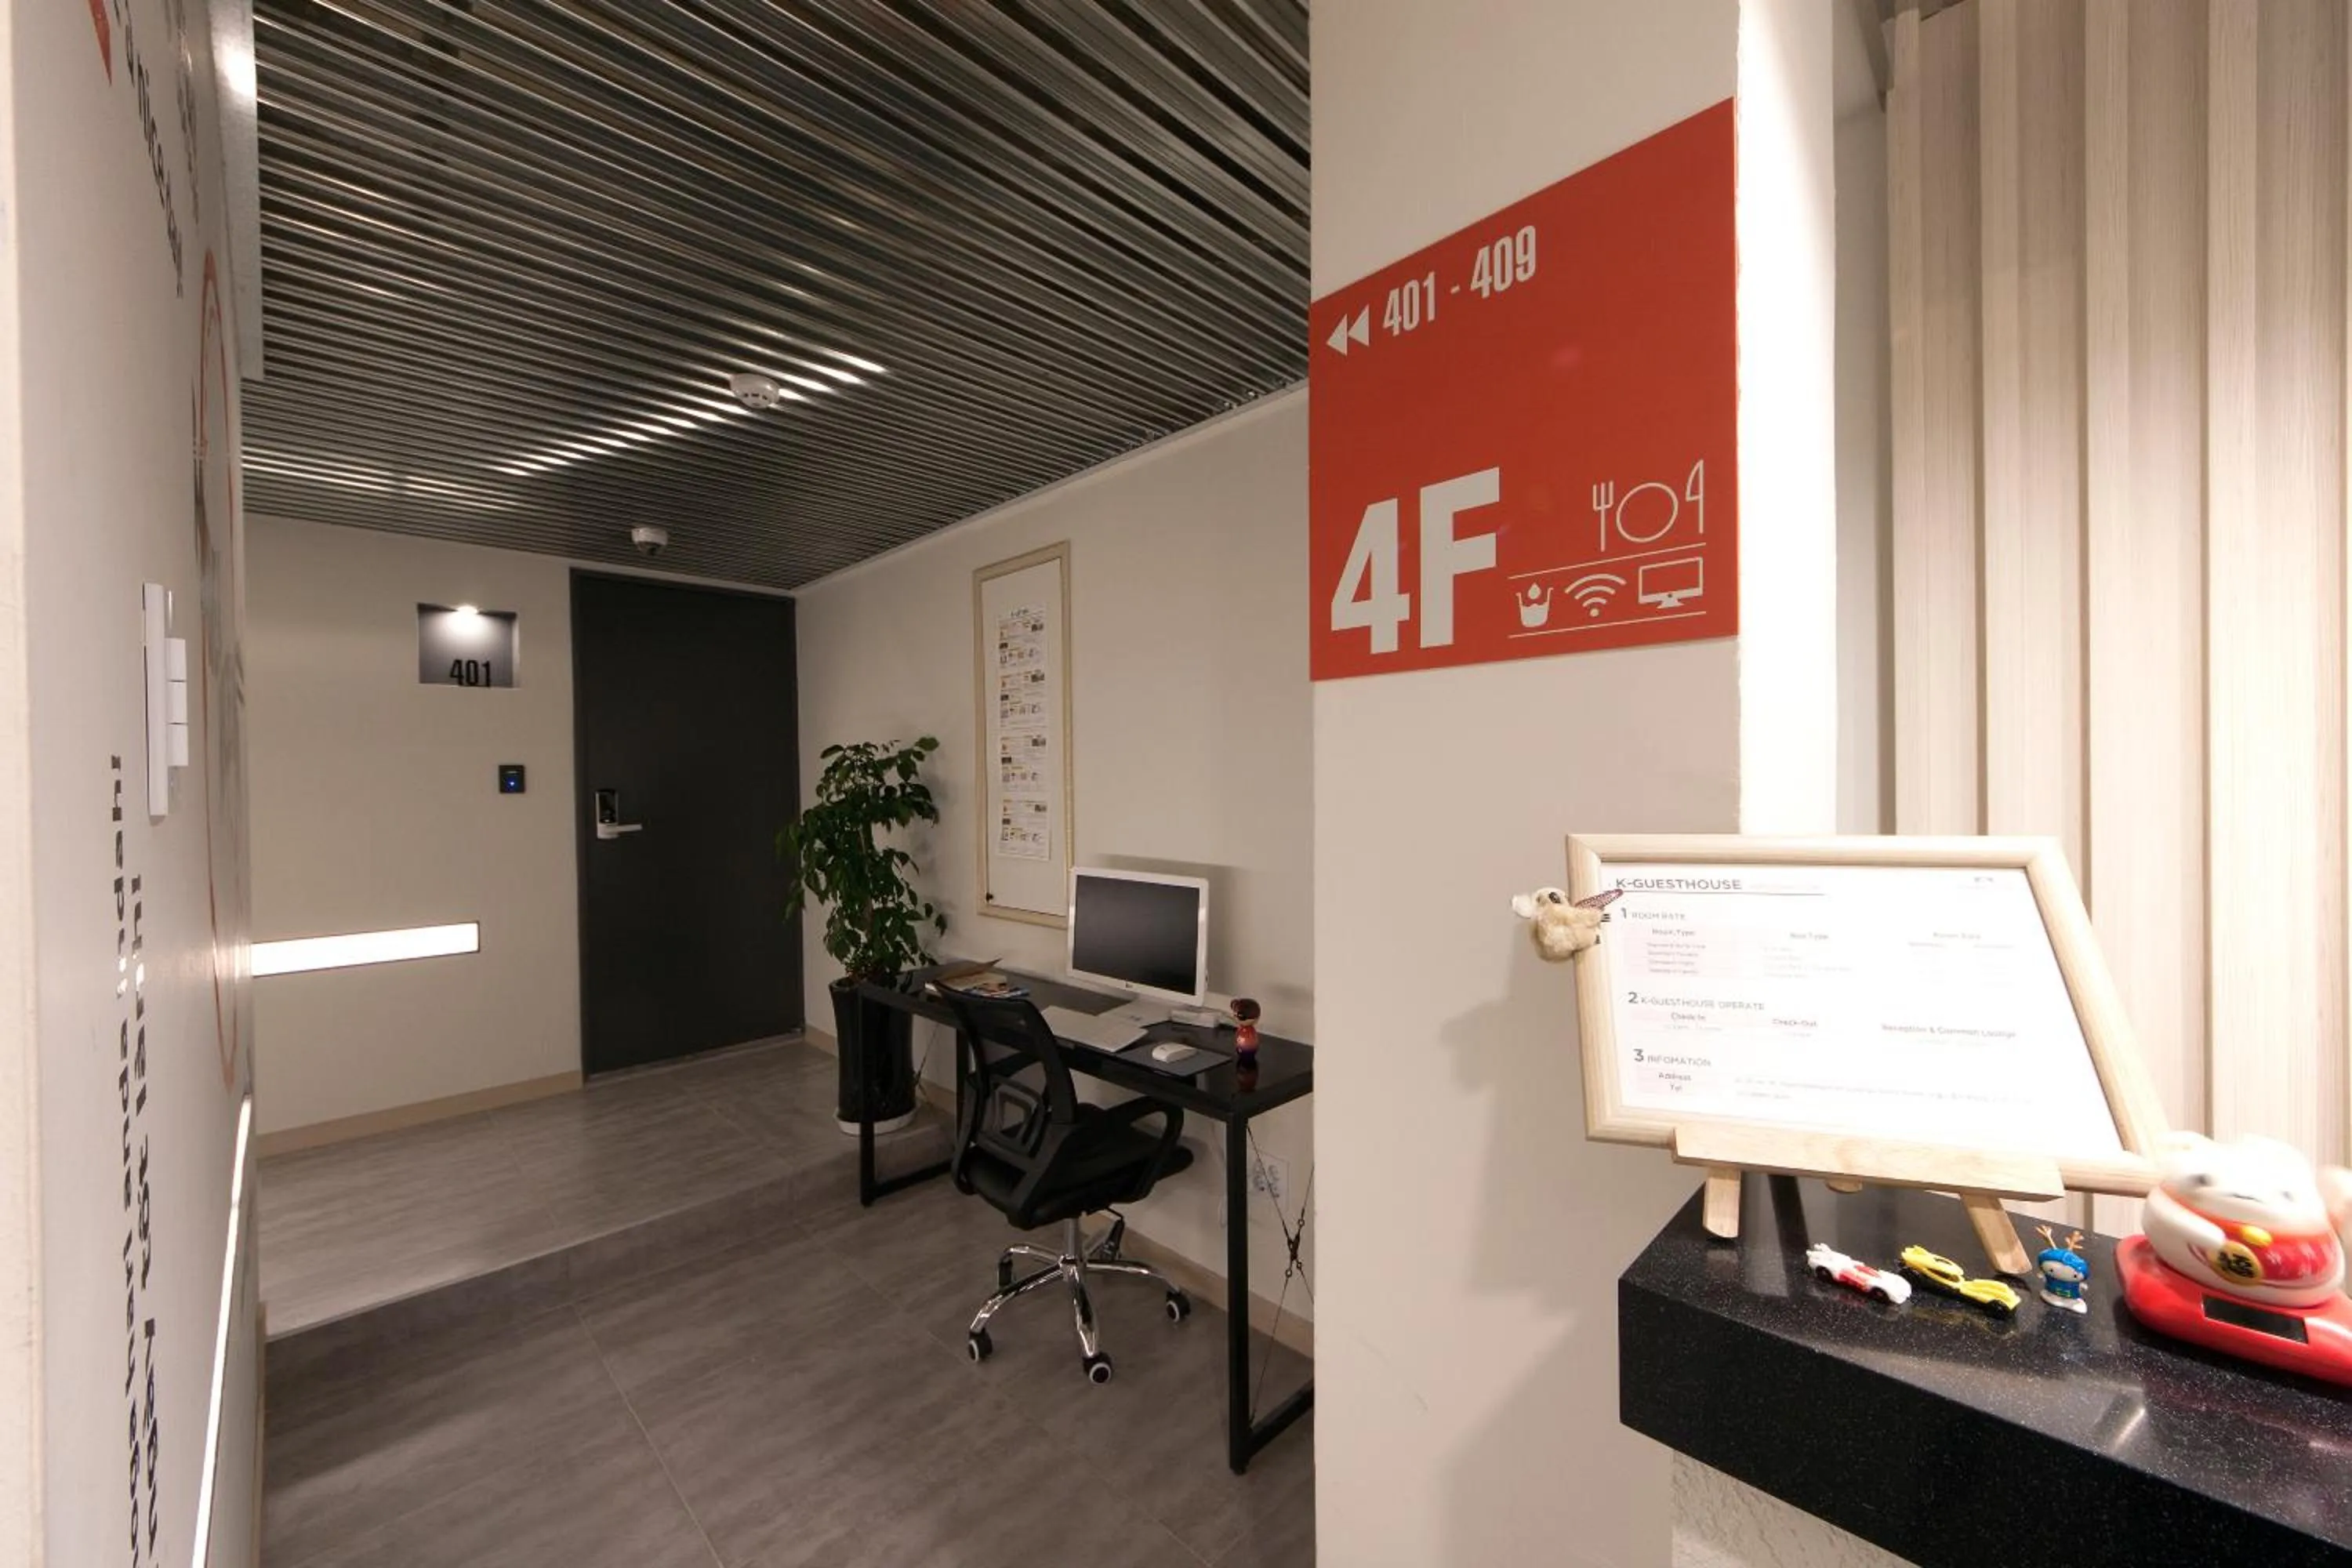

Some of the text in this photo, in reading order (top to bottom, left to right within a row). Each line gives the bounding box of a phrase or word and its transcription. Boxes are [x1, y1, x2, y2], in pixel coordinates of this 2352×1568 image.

[1383, 271, 1436, 337] 401
[1470, 224, 1537, 299] 409
[1330, 466, 1500, 655] 4F
[448, 659, 492, 688] 401
[1615, 877, 1743, 891] K-GUESTHOUSE
[1627, 991, 1639, 1004] 2
[1633, 1048, 1645, 1062] 3
[118, 1017, 132, 1212] anda
[123, 1229, 136, 1397] hari
